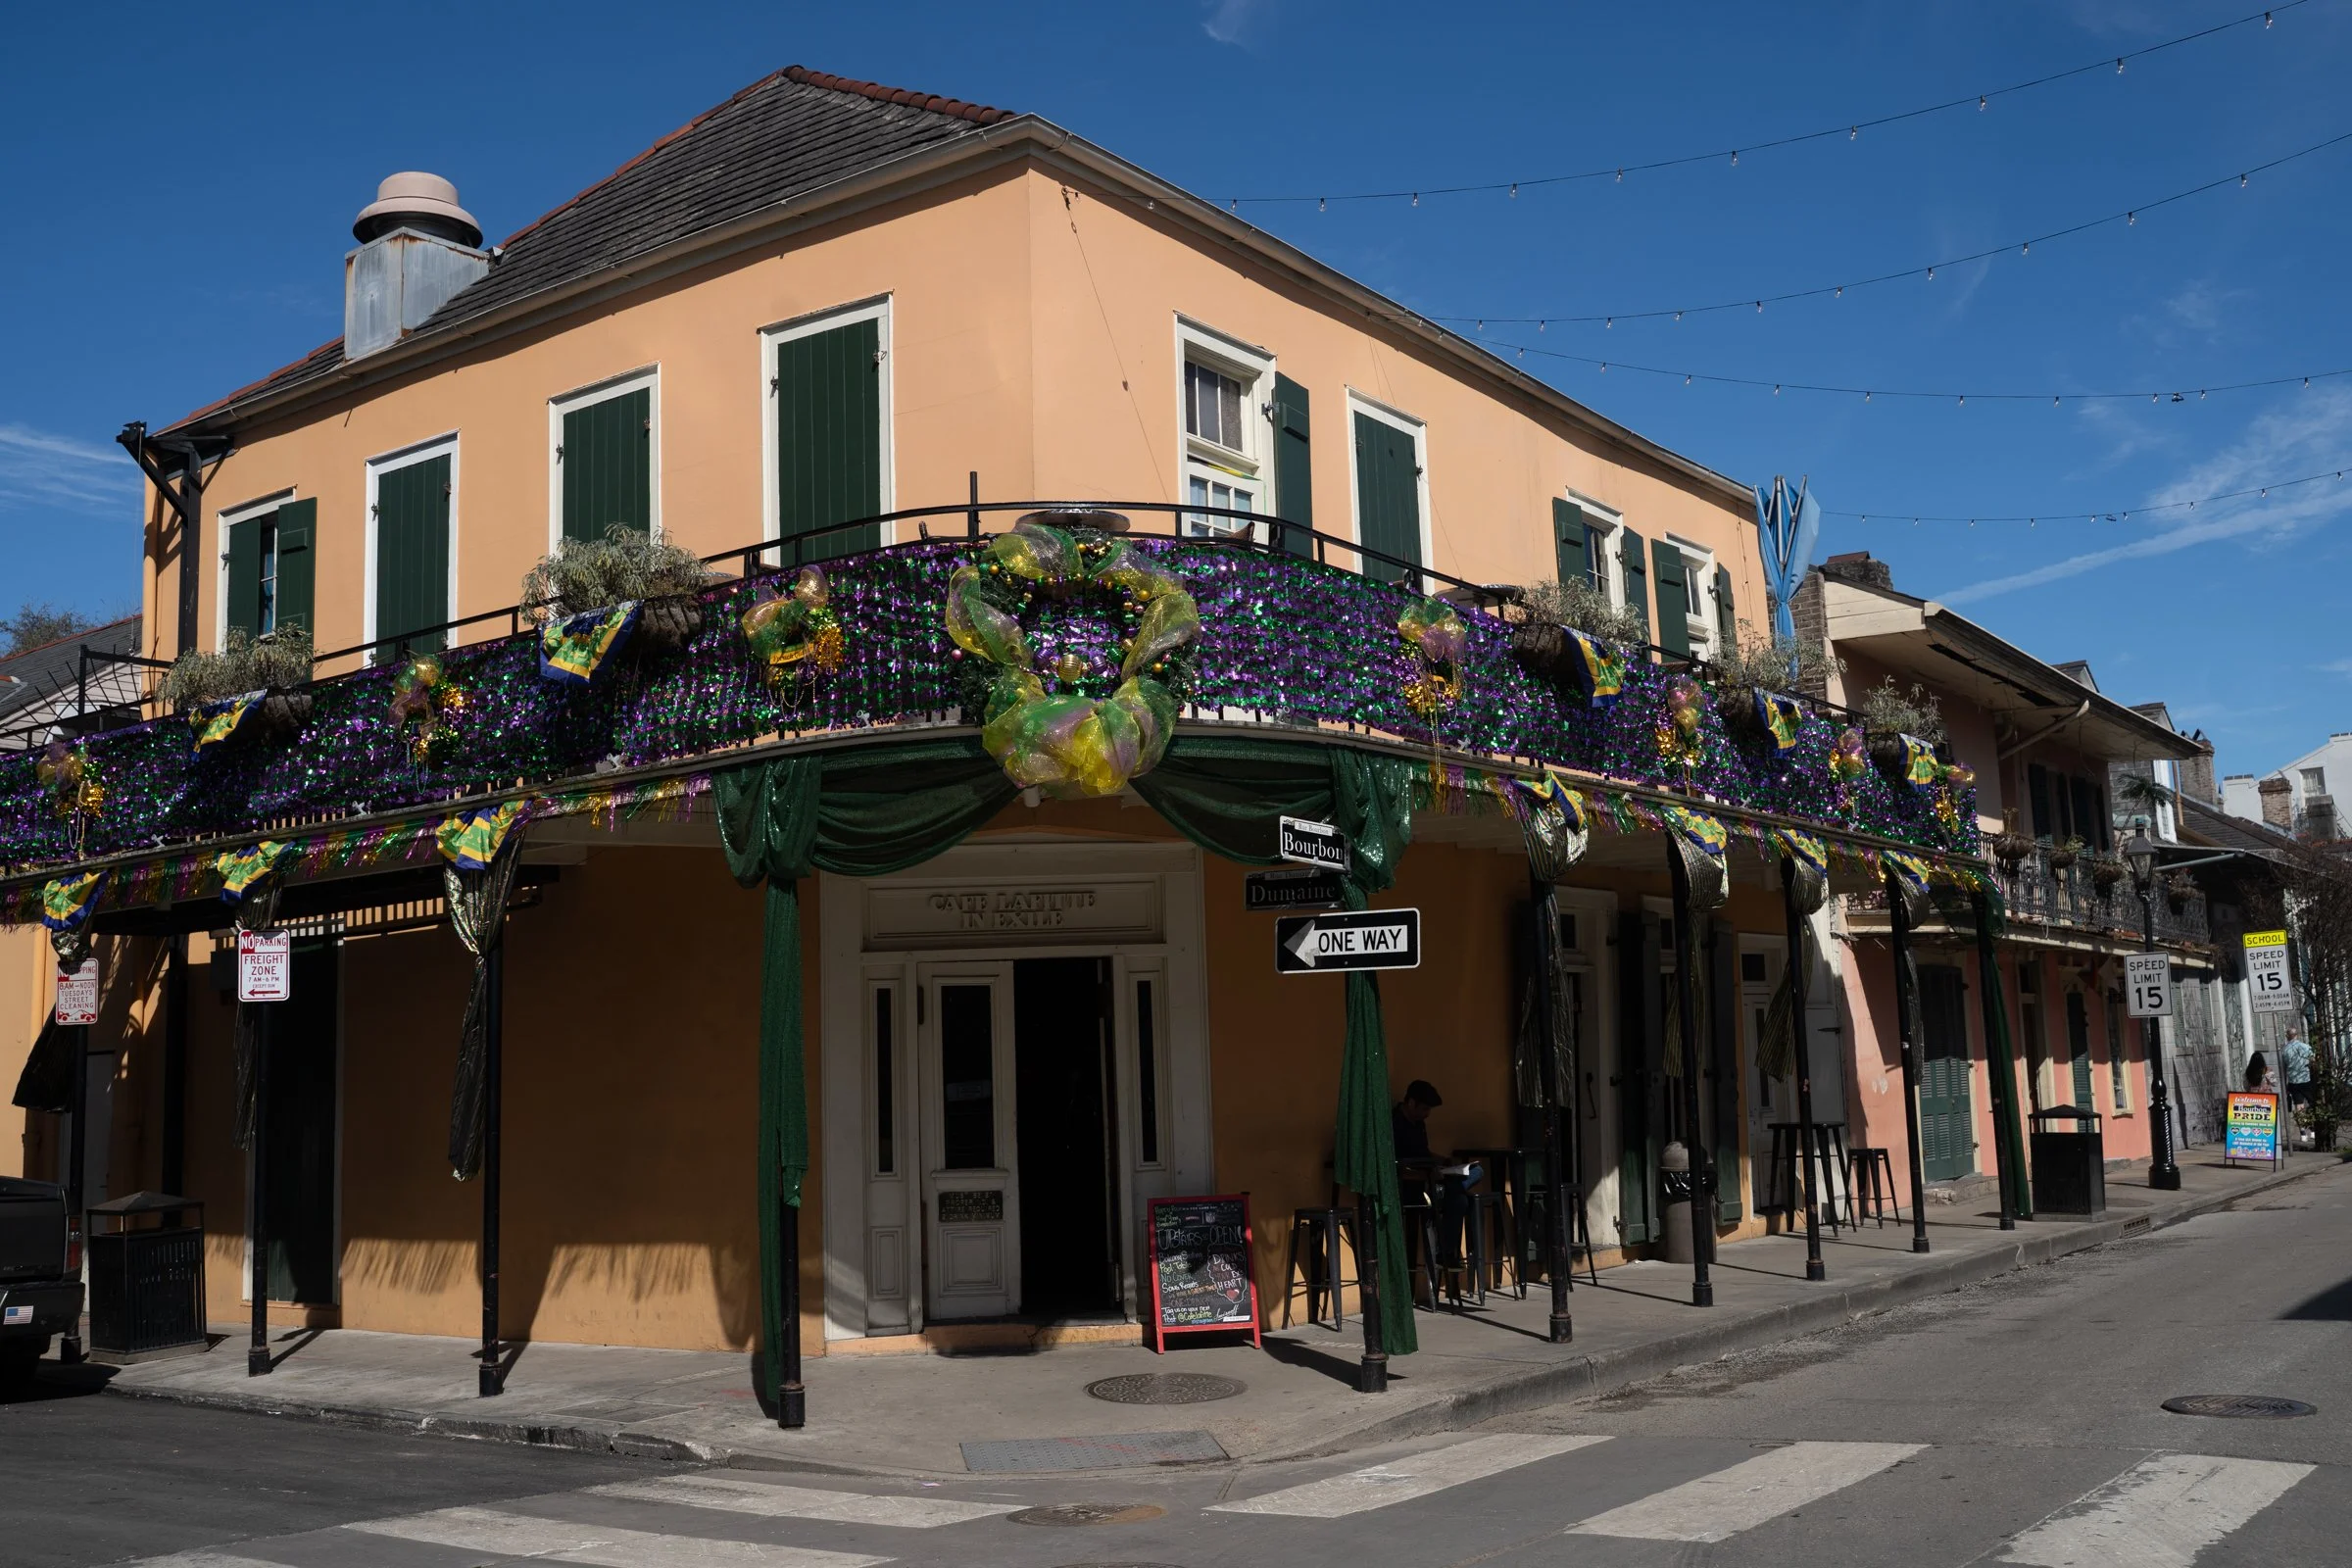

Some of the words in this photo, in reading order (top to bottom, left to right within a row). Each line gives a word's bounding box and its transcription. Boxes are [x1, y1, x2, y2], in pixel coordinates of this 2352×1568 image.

[1283, 831, 1345, 860] Bourbon
[996, 891, 1097, 910] LAFITTE
[1250, 883, 1337, 904] Dumaine
[960, 910, 983, 929] IN
[993, 909, 1064, 928] EXILE
[242, 935, 255, 949] NO
[256, 938, 286, 947] PARKING
[1318, 931, 1355, 954] ONE
[1362, 928, 1402, 951] WAY
[2246, 934, 2283, 945] SCHOOL
[244, 955, 284, 964] FREIGHT
[2249, 951, 2284, 960] SPEED
[251, 965, 276, 975] ZONE
[2129, 960, 2165, 971] SPEED
[2253, 960, 2281, 970] LIMIT
[2133, 973, 2161, 984] LIMIT
[2257, 972, 2282, 991] 15
[2135, 987, 2163, 1009] 15
[2233, 1112, 2271, 1121] PRIDE
[1217, 1277, 1243, 1291] HEART
